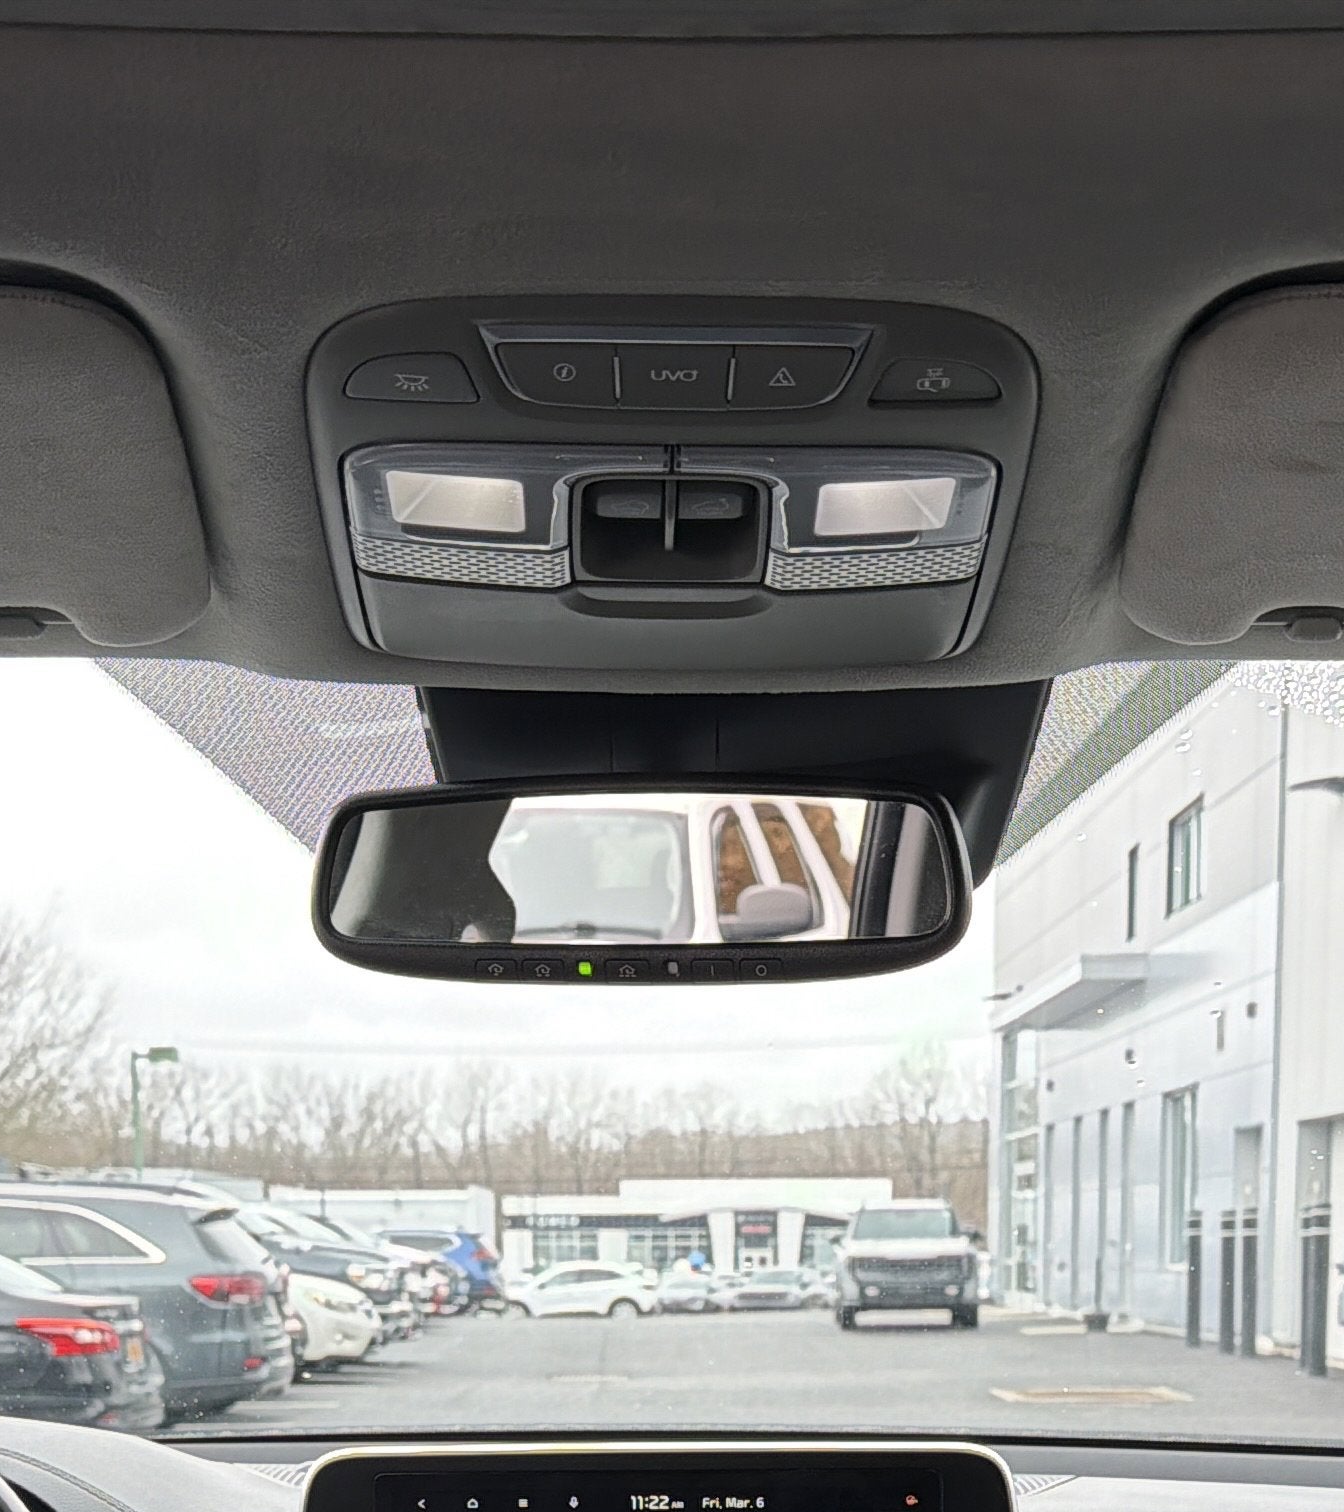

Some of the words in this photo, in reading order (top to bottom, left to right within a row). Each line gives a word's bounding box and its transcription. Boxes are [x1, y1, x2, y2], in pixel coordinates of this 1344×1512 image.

[630, 1495, 670, 1510] 11:22
[725, 1497, 754, 1509] Mar.
[756, 1497, 765, 1509] 6
